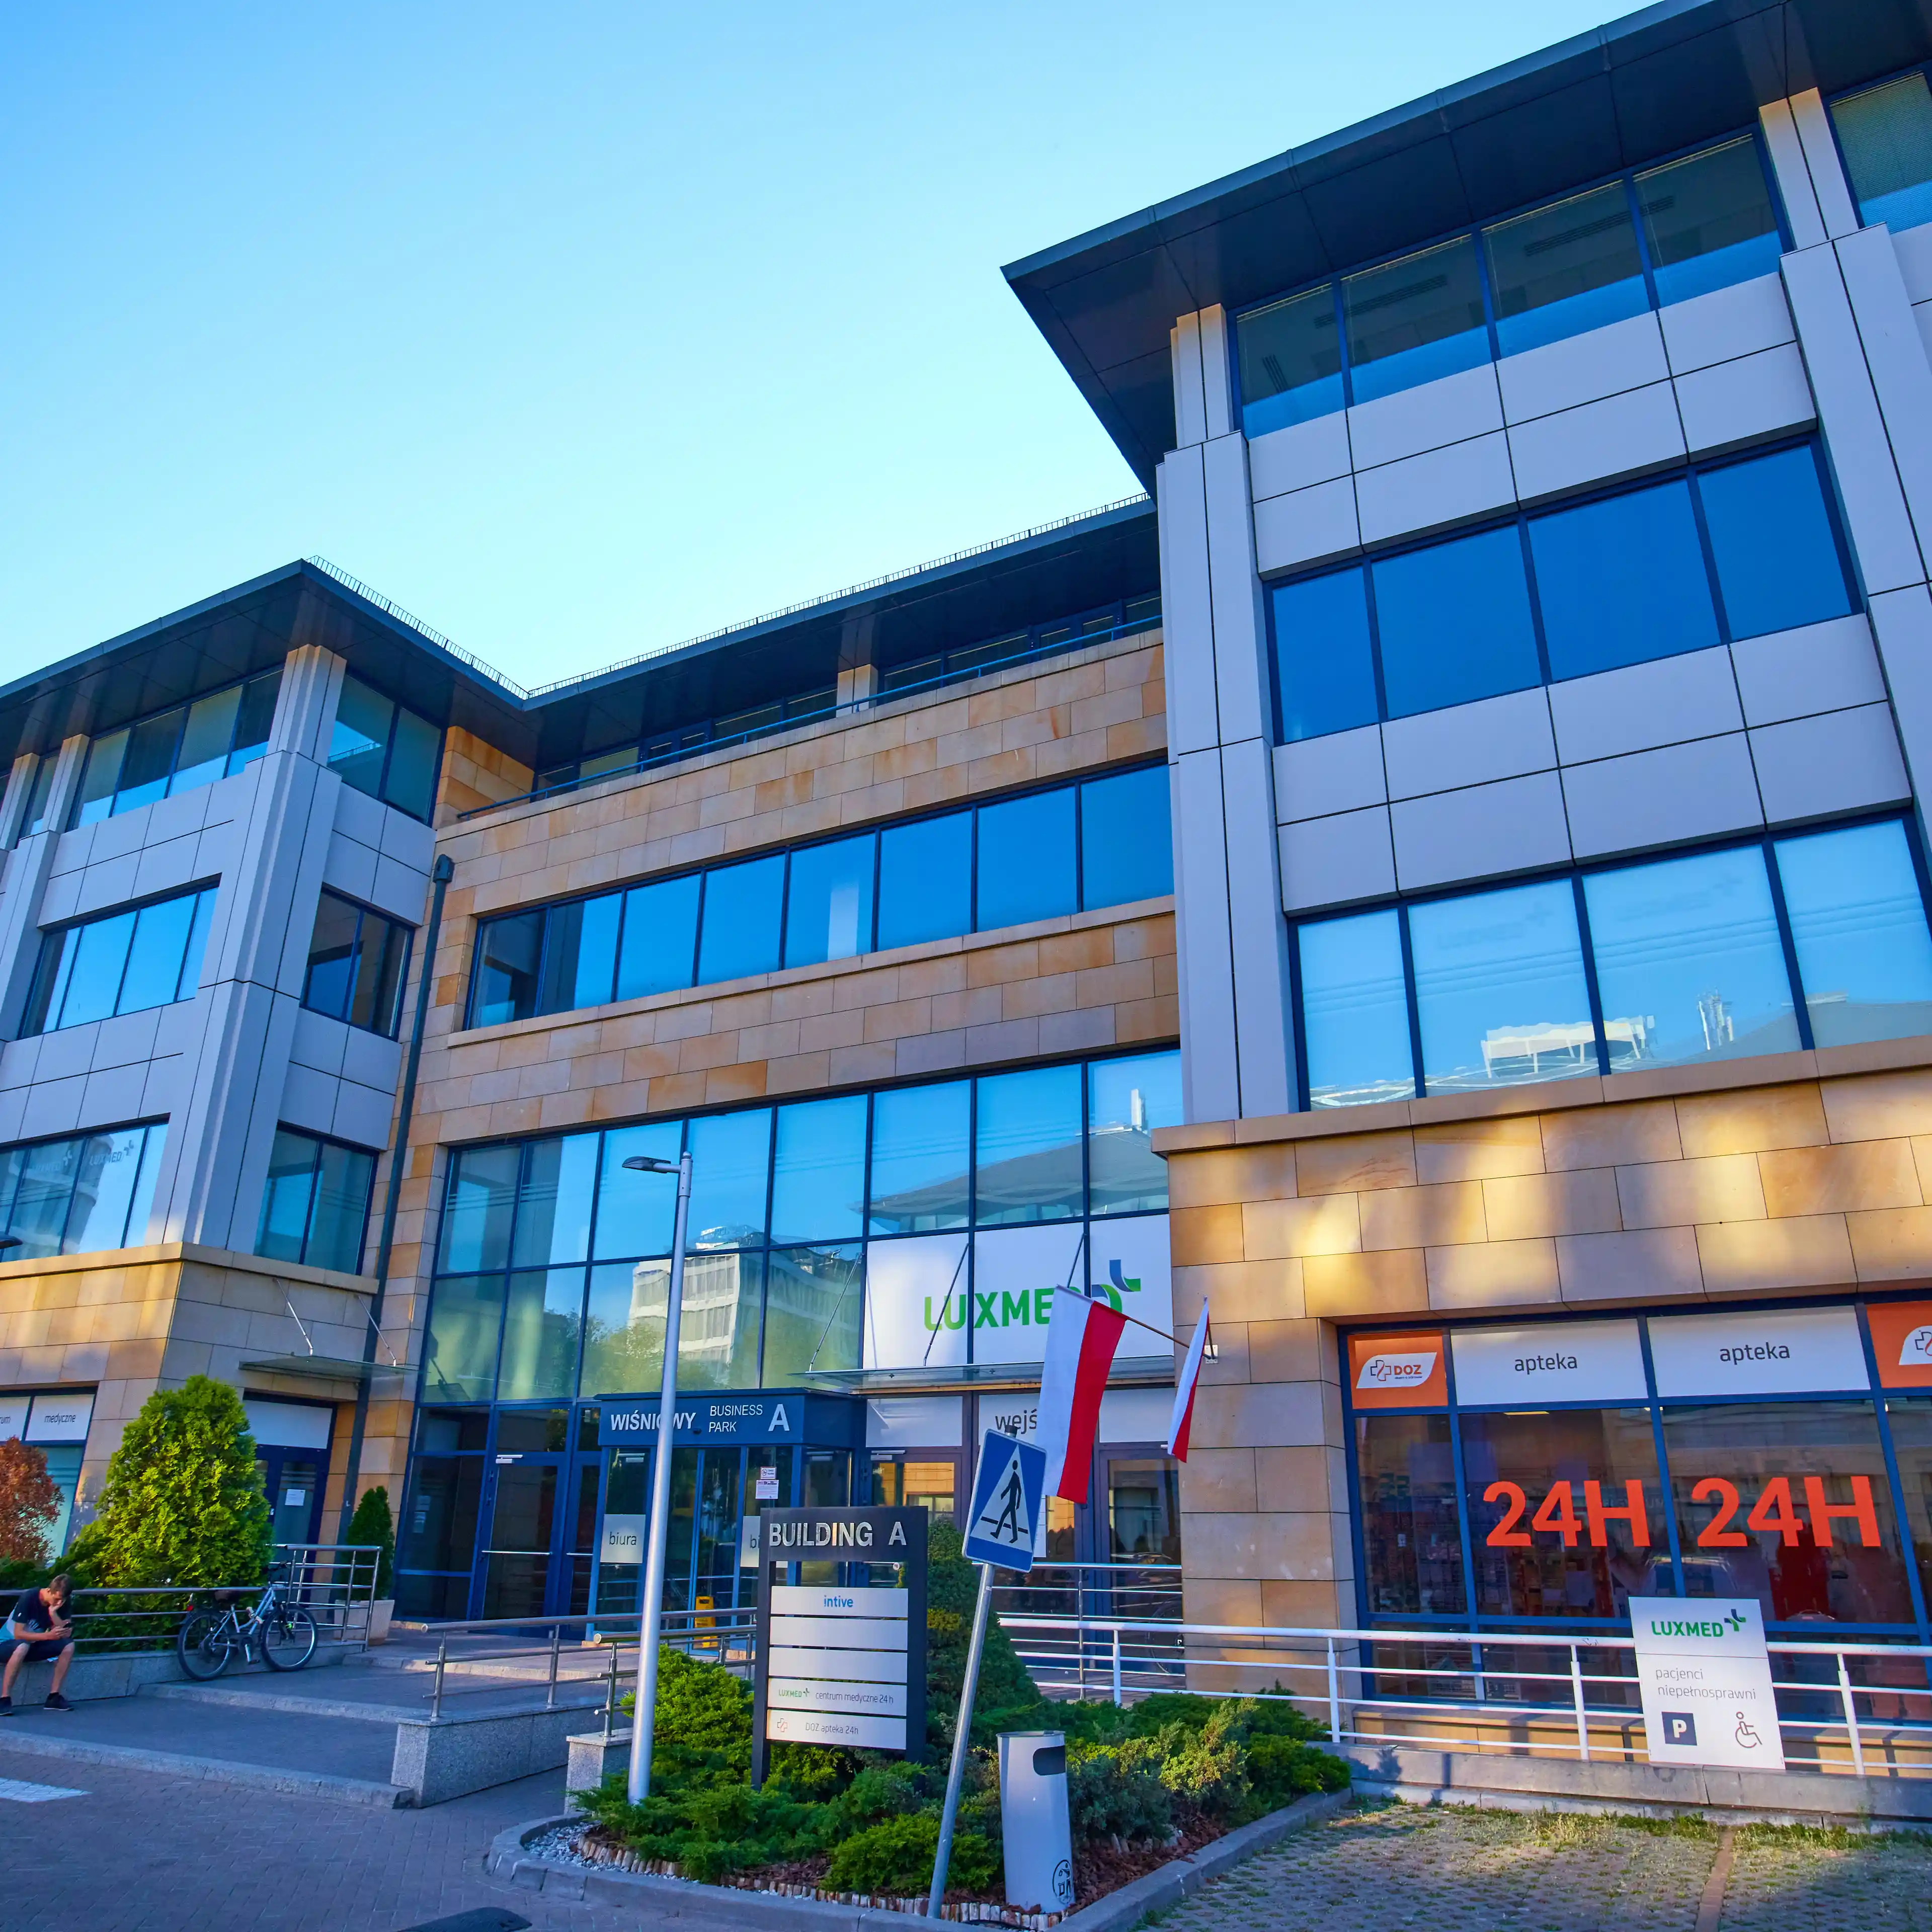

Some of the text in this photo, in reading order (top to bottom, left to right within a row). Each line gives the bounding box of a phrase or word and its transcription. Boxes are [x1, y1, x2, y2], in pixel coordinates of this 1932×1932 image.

[924, 1286, 1082, 1331] LUXME
[1720, 1341, 1790, 1365] apteka
[1394, 1364, 1422, 1375] DOZ
[1514, 1353, 1578, 1375] apteka
[710, 1404, 763, 1416] BUSINESS
[768, 1404, 790, 1431] A
[44, 1413, 76, 1425] medyczne
[708, 1421, 737, 1432] PARK
[995, 1408, 1037, 1434] wejś
[1483, 1480, 1650, 1547] 24H
[1691, 1476, 1881, 1547] 24H
[609, 1532, 636, 1546] biura
[769, 1521, 873, 1547] BUILDING
[888, 1521, 907, 1546] A
[824, 1595, 853, 1607] intive
[1651, 1621, 1724, 1637] LUXMED
[1656, 1667, 1704, 1681] pacjenci
[779, 1689, 802, 1698] LUXMED
[816, 1692, 843, 1701] centrum
[844, 1692, 878, 1704] medyczne
[1658, 1685, 1756, 1700] niepełnosprawni
[806, 1722, 858, 1734] DOZ apteka 24h
[1672, 1719, 1687, 1738] P
